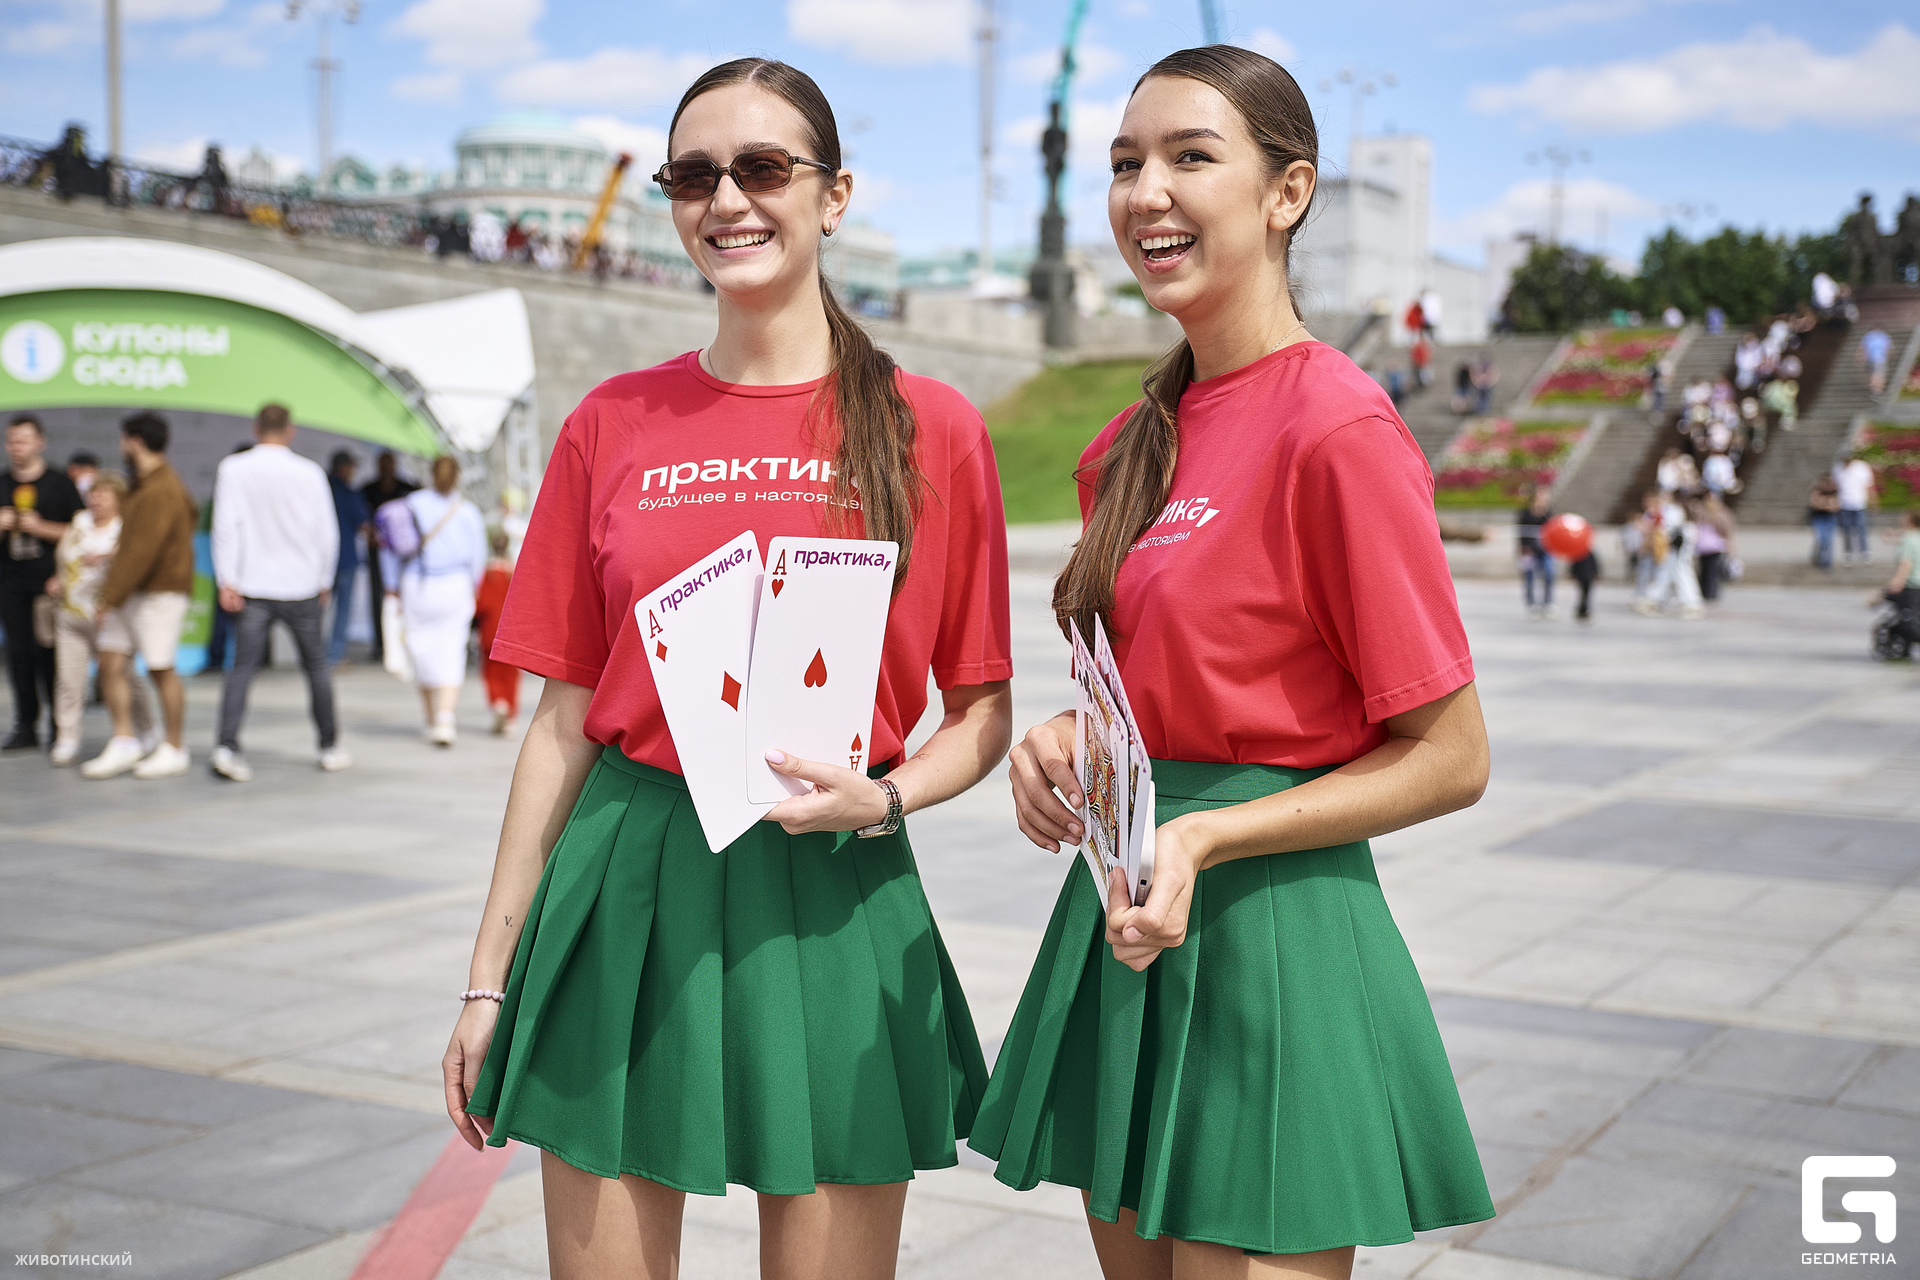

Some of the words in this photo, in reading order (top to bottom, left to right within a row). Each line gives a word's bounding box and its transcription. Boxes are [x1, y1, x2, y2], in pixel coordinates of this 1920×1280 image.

[72, 321, 230, 356] КУПОНЫ
[72, 354, 189, 391] СЮДА
[638, 491, 727, 511] будущее
[734, 492, 747, 502] в
[754, 491, 864, 511] настояще
[1136, 531, 1192, 551] настоящем
[772, 548, 787, 576] A
[794, 549, 892, 572] практика,
[660, 547, 753, 614] практика,
